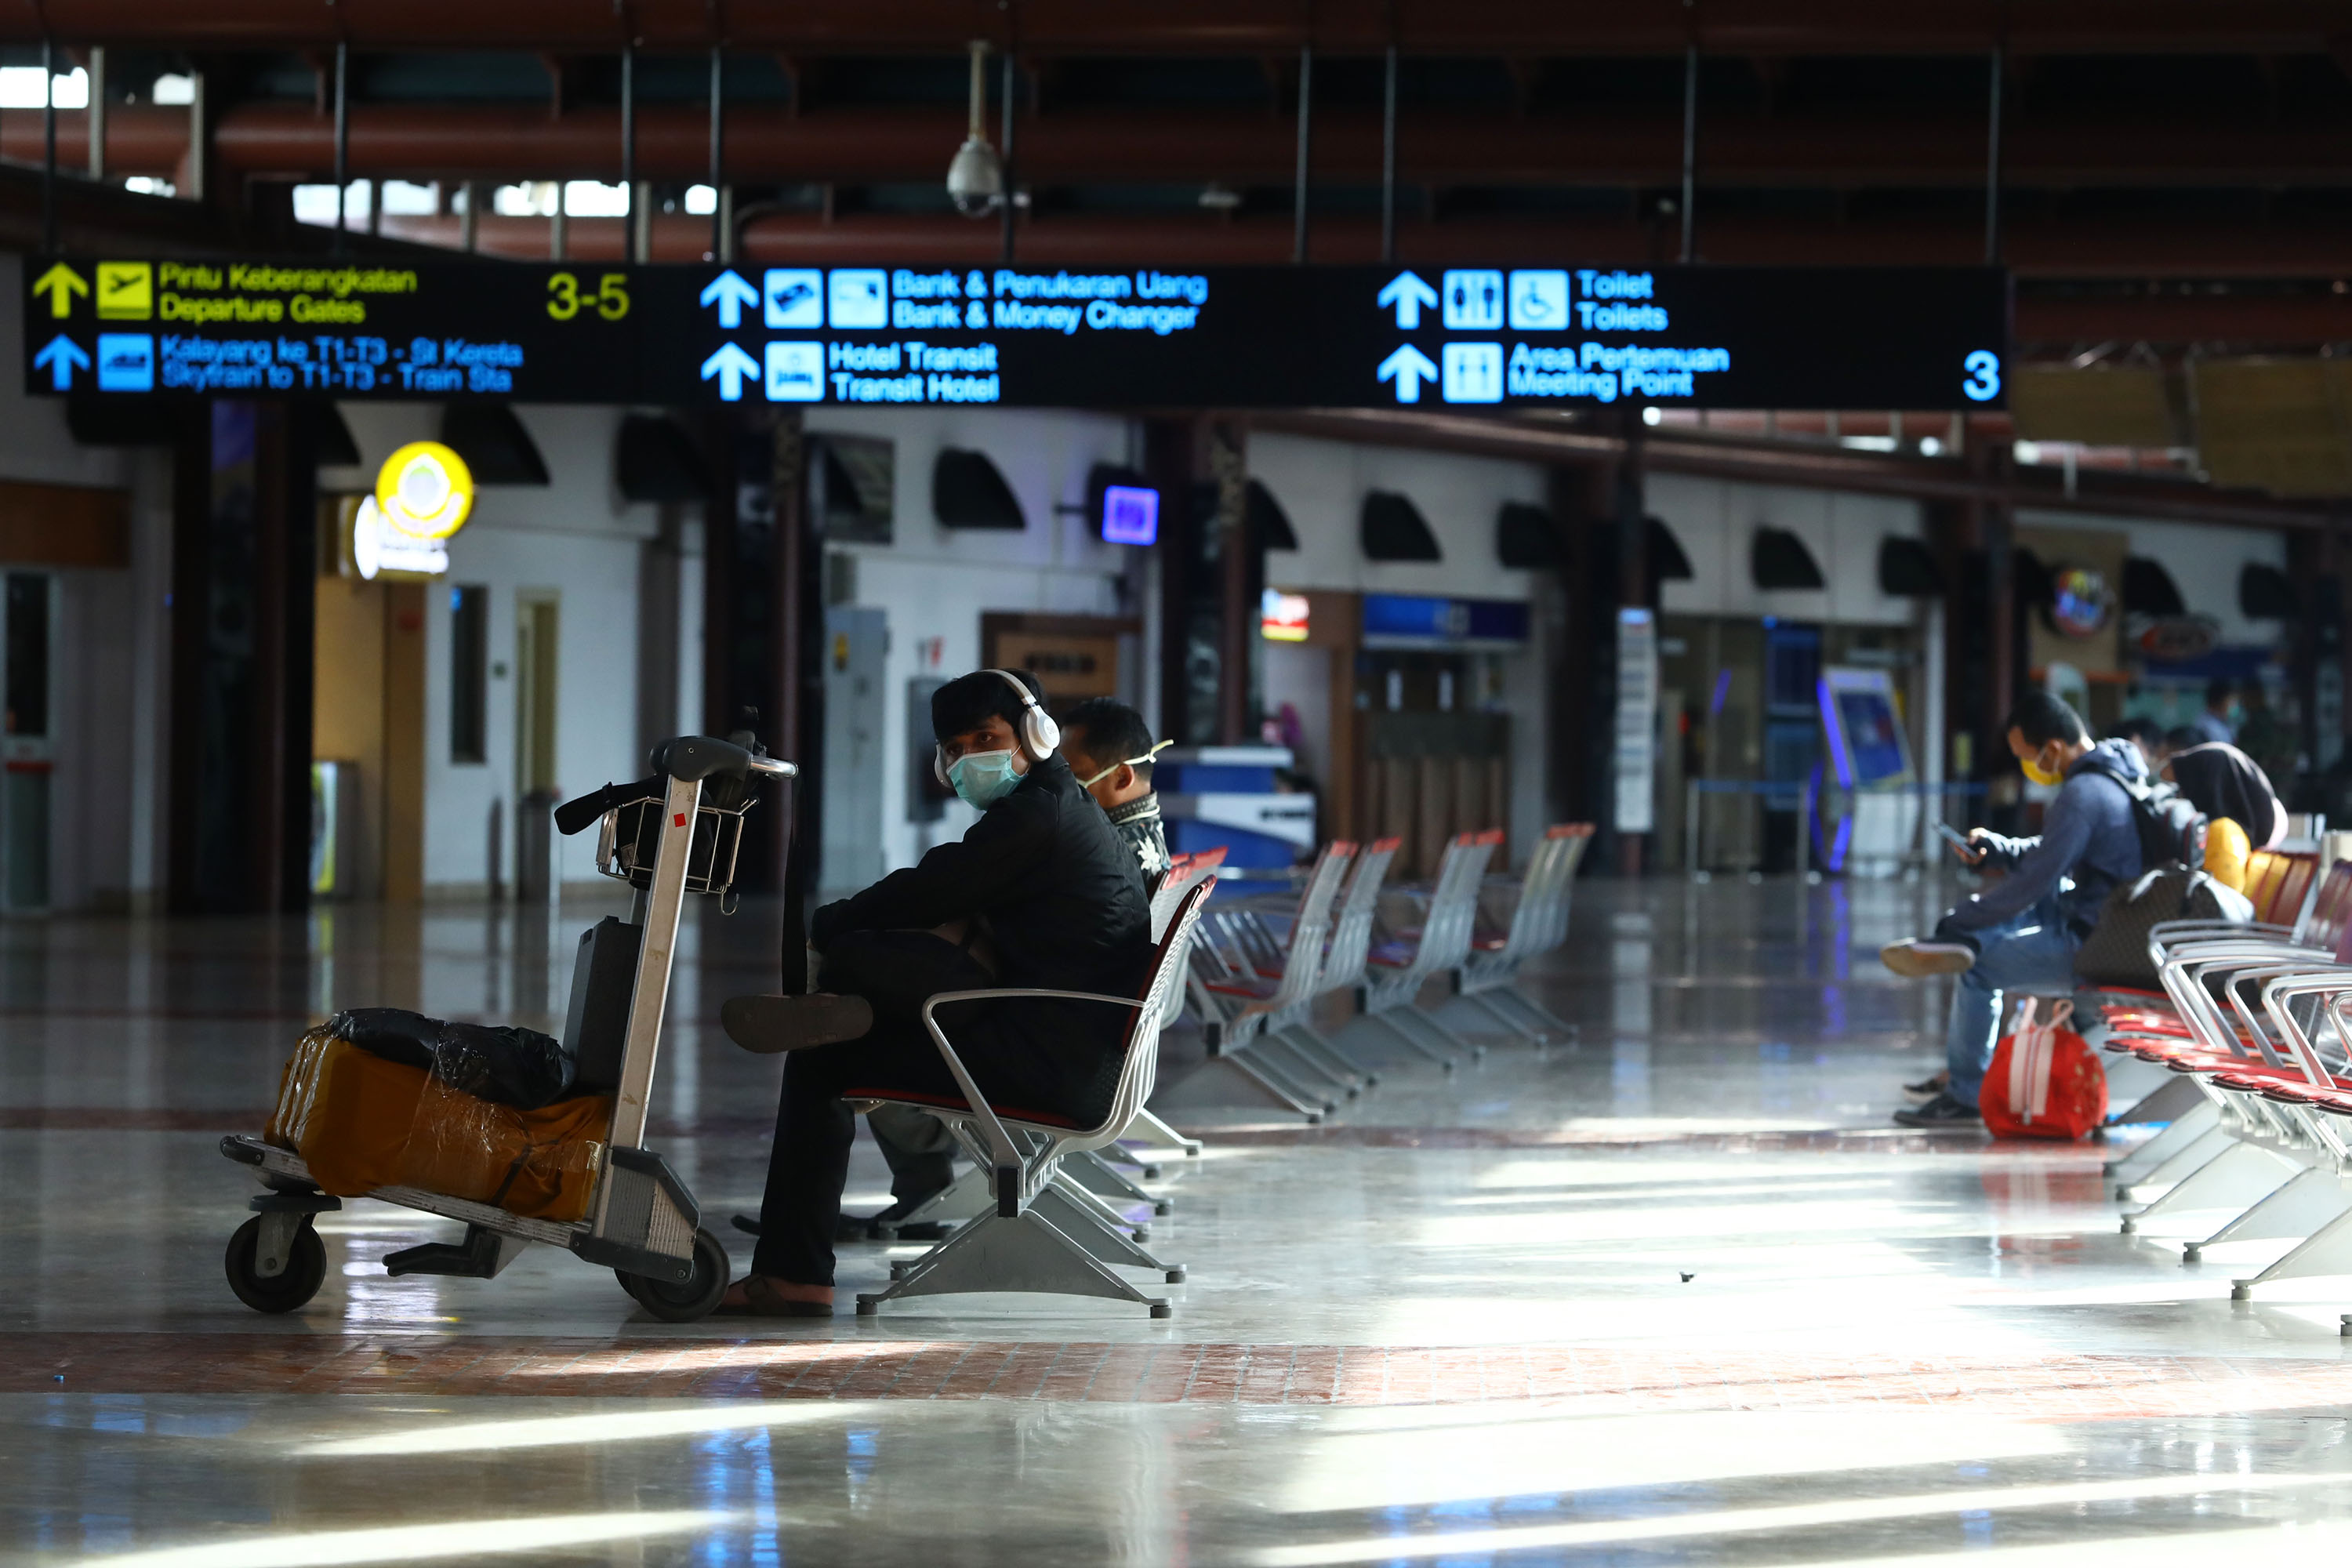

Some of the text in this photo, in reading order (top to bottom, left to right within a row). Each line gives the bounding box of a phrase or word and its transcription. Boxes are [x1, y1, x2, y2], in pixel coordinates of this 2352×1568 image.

[160, 264, 416, 297] Pintu Keberangkatan
[548, 272, 629, 320] 3-5
[892, 269, 1208, 305] Bank & Penukaran Uang
[1574, 269, 1654, 299] Toilet
[160, 292, 365, 324] Departure Gates
[892, 299, 1200, 336] Bank & Money Changer
[1574, 301, 1669, 331] Toilets
[277, 335, 309, 363] ke
[314, 336, 387, 365] T1-T3
[829, 341, 999, 372] Hotel Transit
[1508, 342, 1730, 372] Area Pertemuan
[267, 364, 294, 389] to
[397, 361, 463, 391] Train
[829, 372, 1000, 402] Transit Hotel
[1508, 368, 1694, 403] Meeting Point
[1963, 350, 2000, 401] 3
